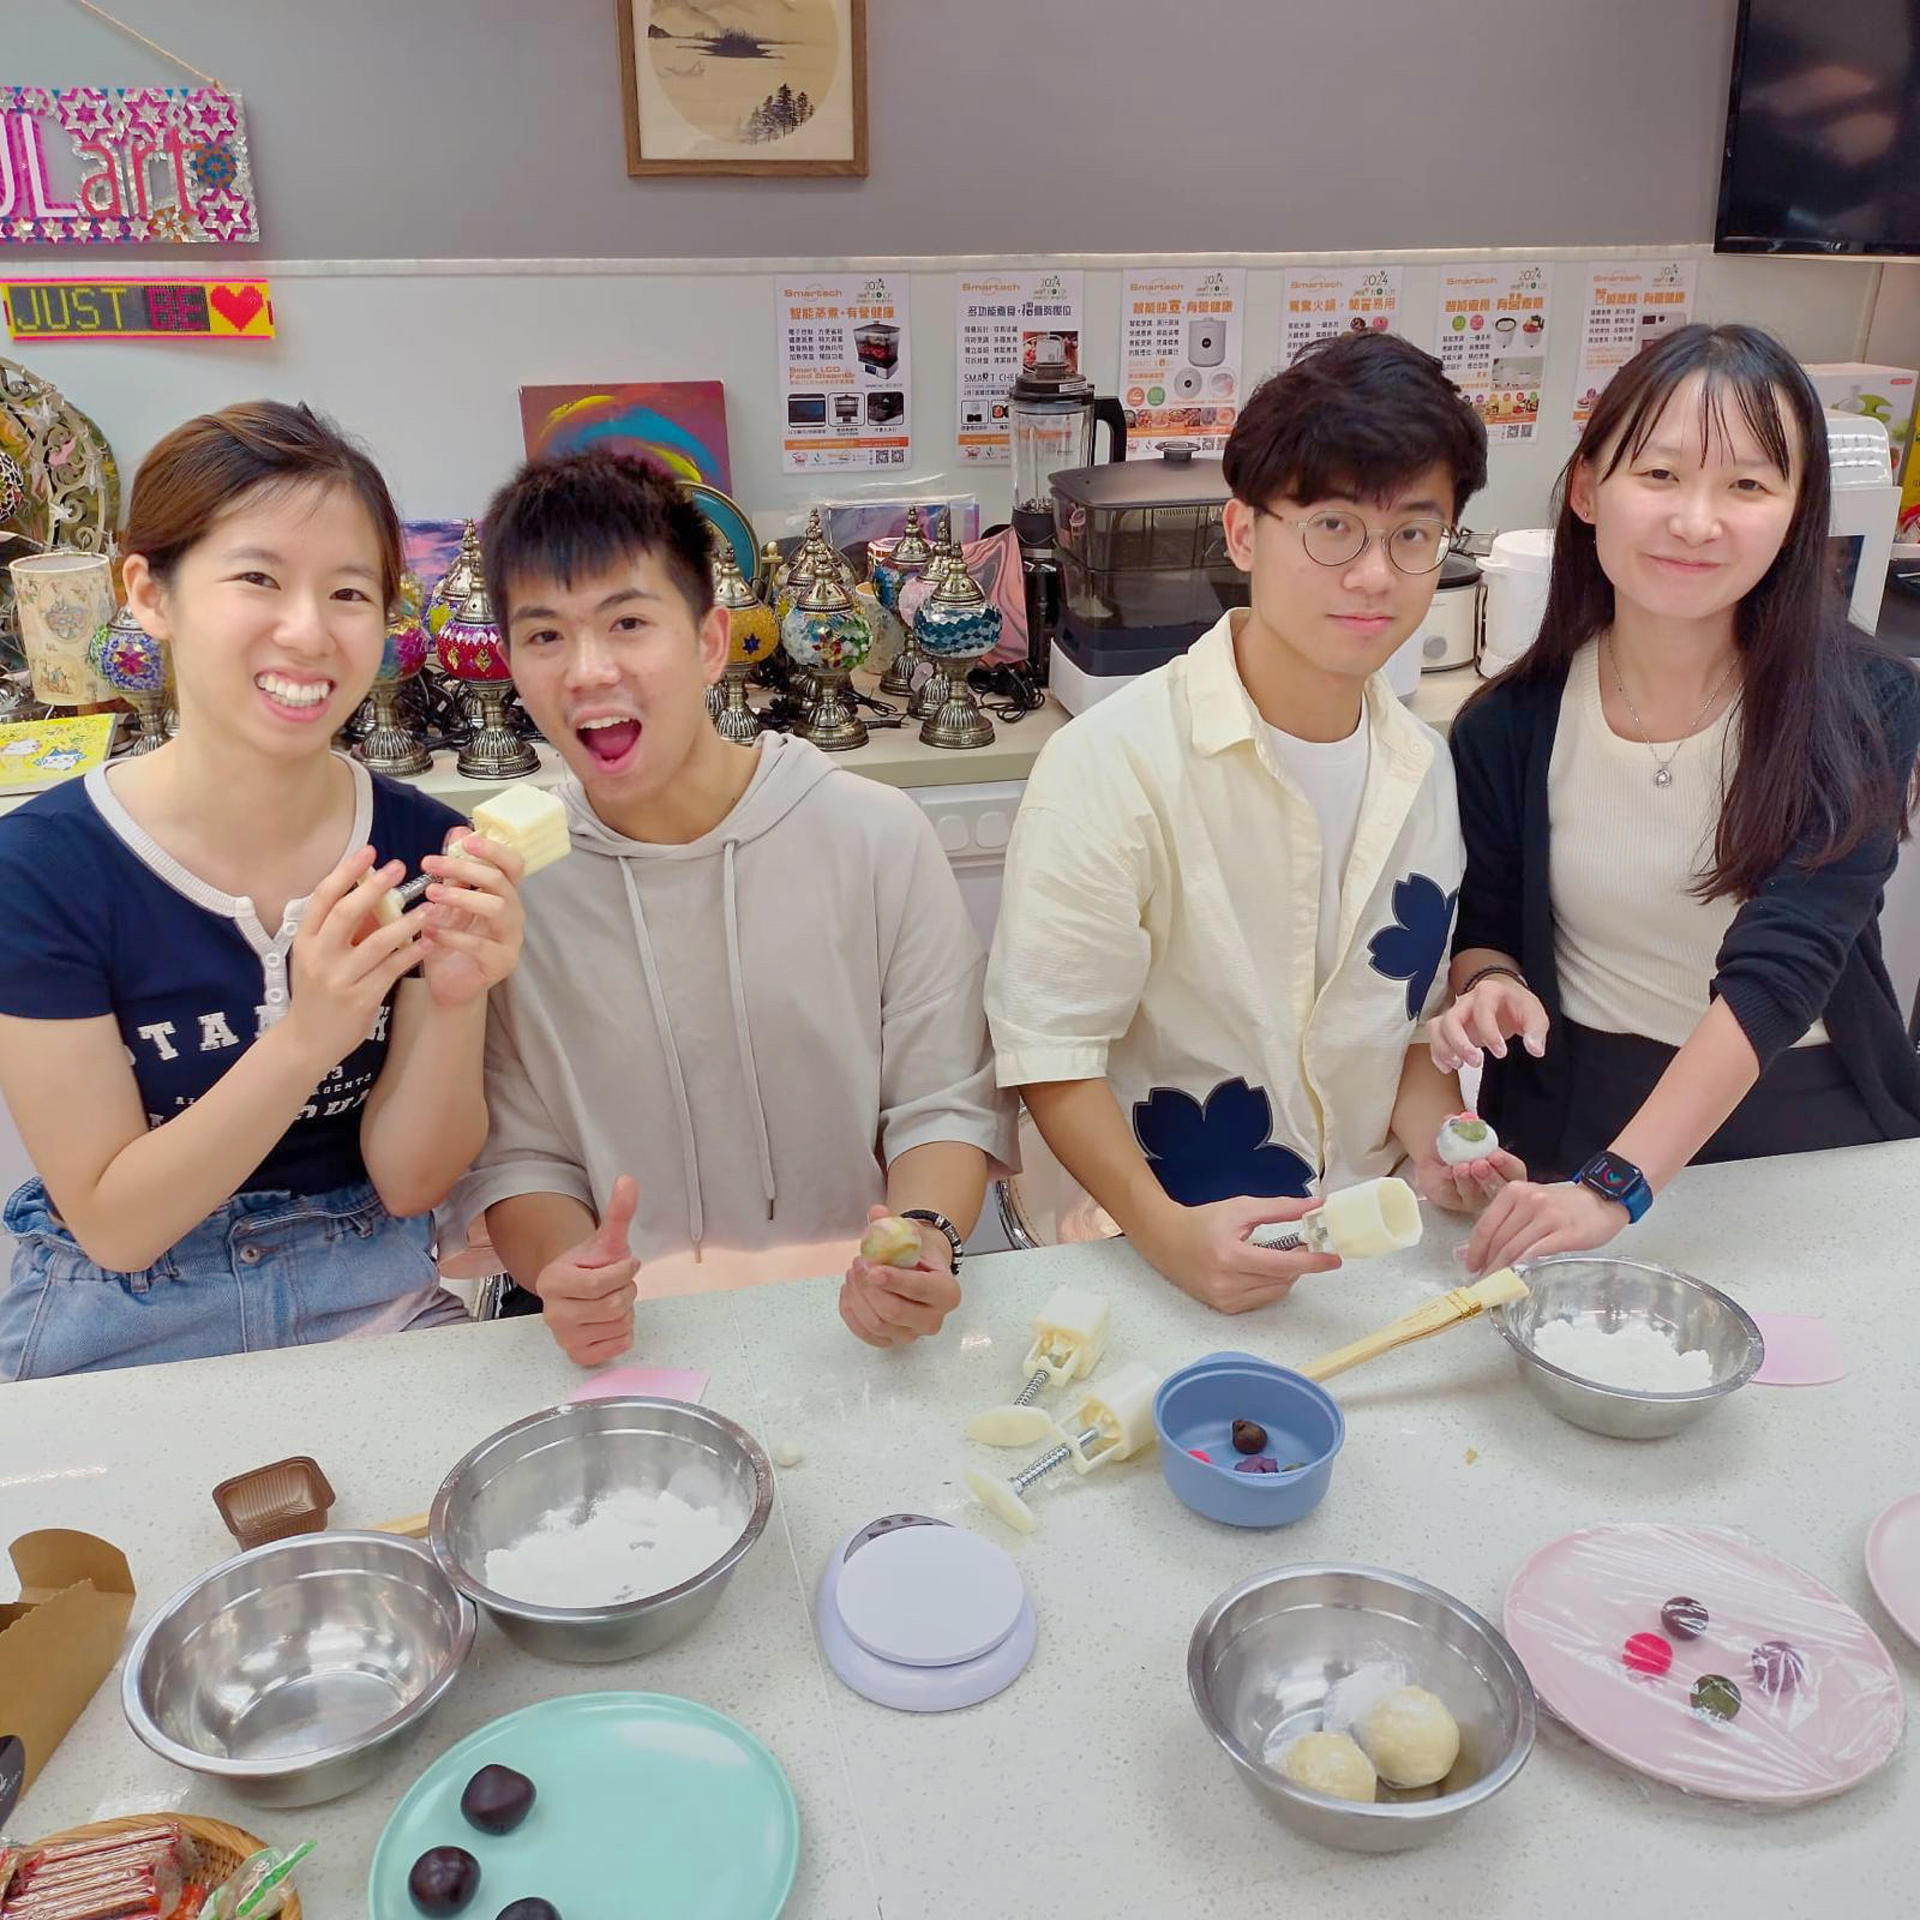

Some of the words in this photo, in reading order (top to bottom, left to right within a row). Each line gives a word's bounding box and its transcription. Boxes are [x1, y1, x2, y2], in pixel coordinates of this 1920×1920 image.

[1363, 271, 1387, 286] 2024
[1519, 268, 1541, 281] 2024
[784, 288, 842, 299] Smartech
[17, 287, 127, 331] JUST
[963, 373, 995, 383] SMART
